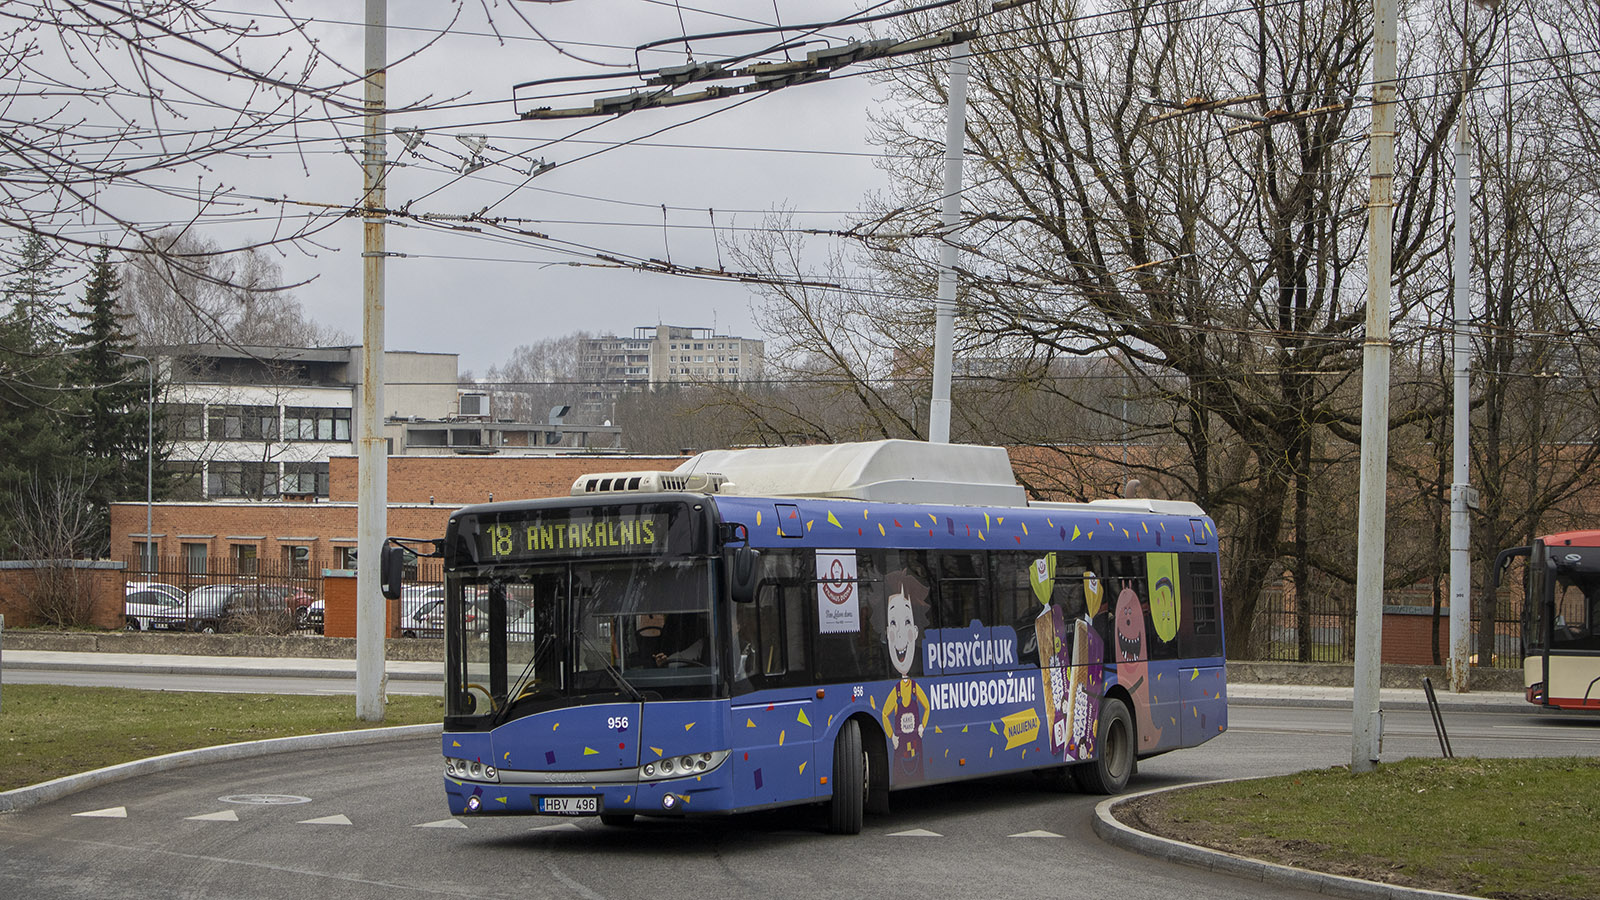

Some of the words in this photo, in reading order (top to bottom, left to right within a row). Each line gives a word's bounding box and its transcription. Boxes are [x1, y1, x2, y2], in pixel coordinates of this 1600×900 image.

[486, 523, 513, 556] 18
[527, 519, 655, 550] ANTAKALNIS
[927, 633, 1014, 669] PUSRYČIAUK
[853, 685, 864, 697] 956
[930, 671, 1036, 711] NENUOBODŽIAI!
[607, 716, 629, 729] 956
[1008, 717, 1038, 738] NAUJIENA!
[544, 773, 588, 783] SOLARIS
[545, 799, 569, 810] HBV
[576, 799, 595, 810] 496
